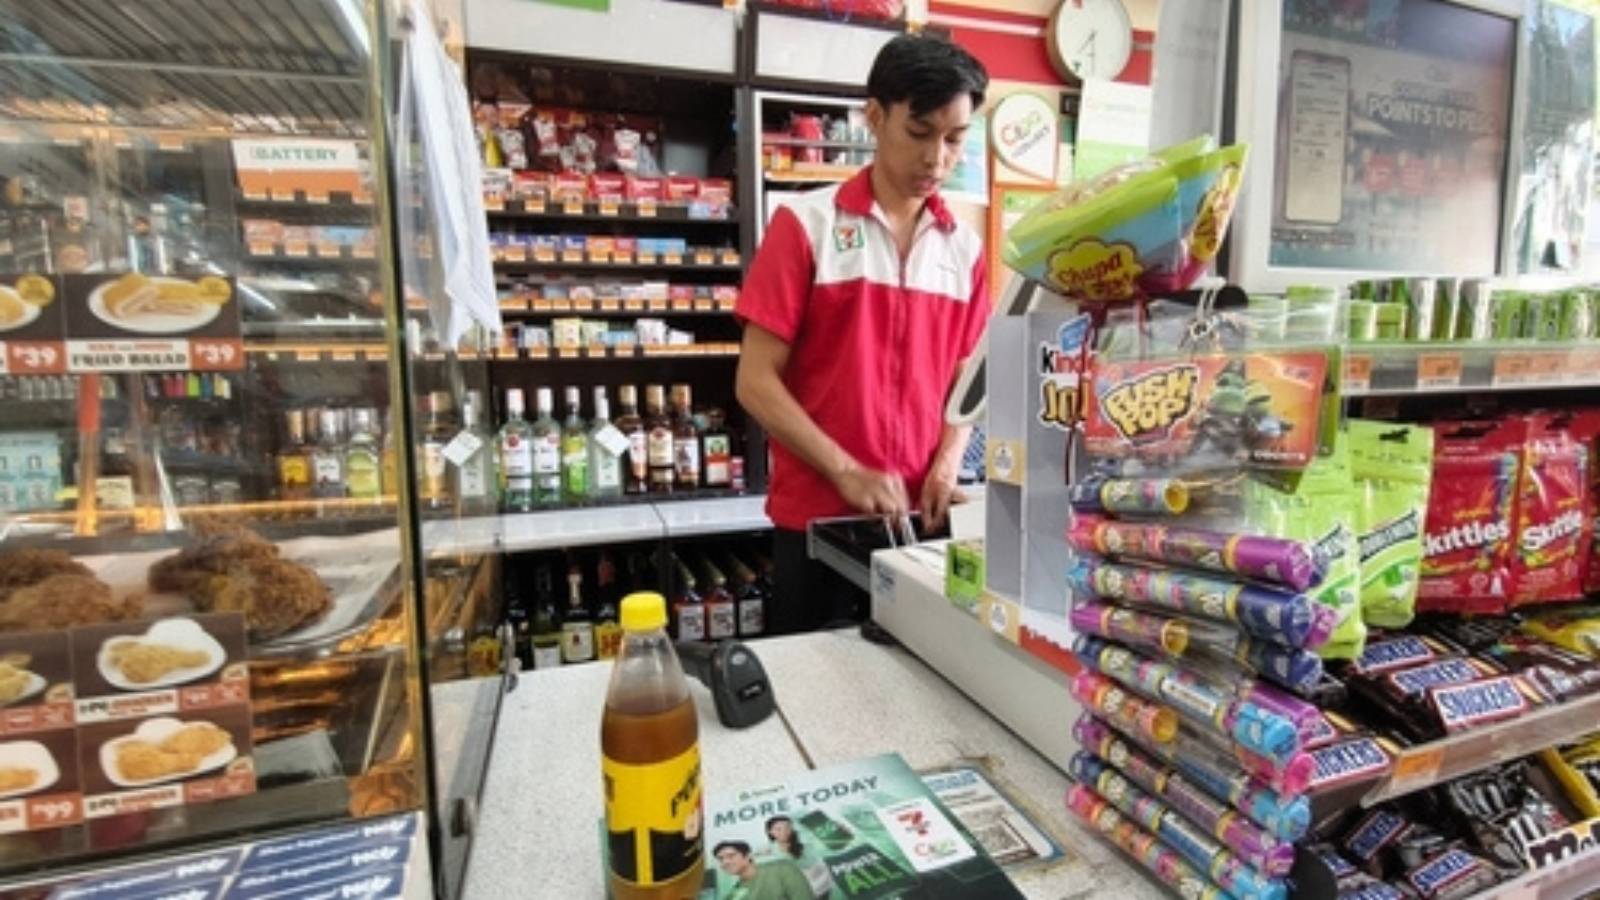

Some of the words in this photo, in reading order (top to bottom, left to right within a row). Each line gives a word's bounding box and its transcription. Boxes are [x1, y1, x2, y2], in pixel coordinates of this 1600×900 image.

[1042, 346, 1094, 373] Kind
[1109, 366, 1197, 412] PUSH
[1117, 398, 1189, 436] POP
[1422, 518, 1510, 557] kittles
[1438, 680, 1520, 722] SNICKERS
[713, 797, 791, 828] MORE
[800, 775, 879, 806] TODAY
